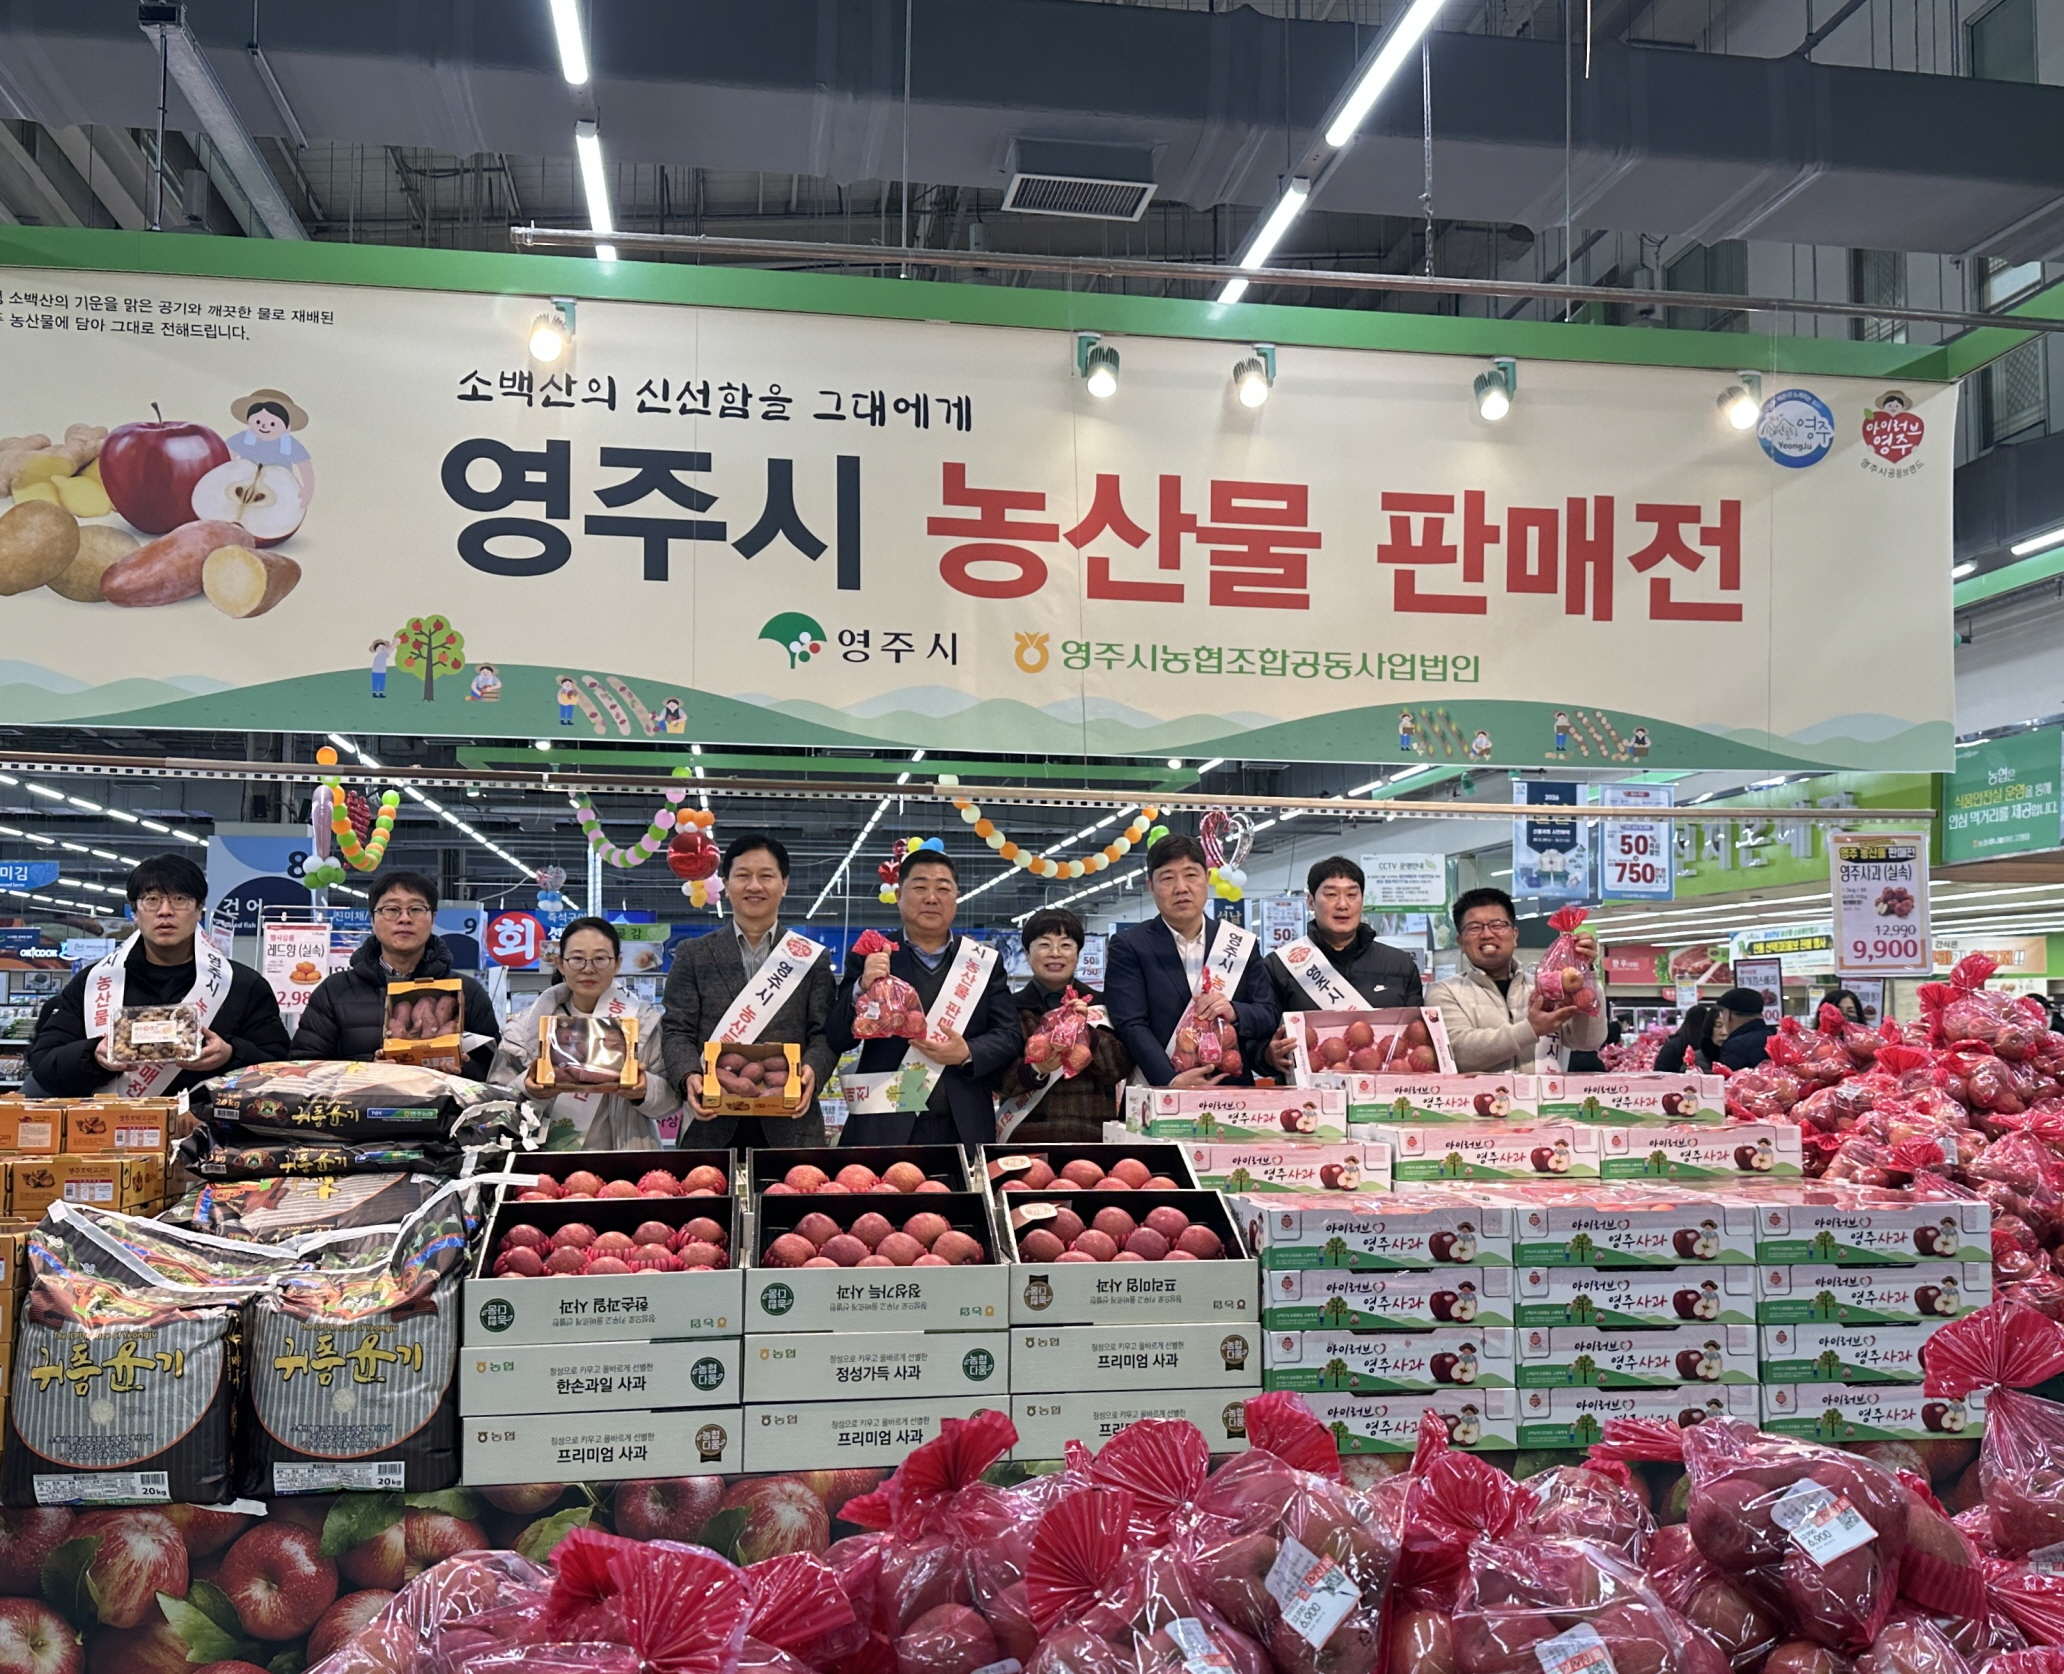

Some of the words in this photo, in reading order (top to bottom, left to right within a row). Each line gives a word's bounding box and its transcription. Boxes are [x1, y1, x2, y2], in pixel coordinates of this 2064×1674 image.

[9, 291, 69, 309] 소백산의
[75, 295, 119, 312] 기운을
[124, 296, 153, 313] 맑은
[158, 299, 202, 317] 공기와
[207, 302, 251, 319] 깨끗한
[257, 306, 286, 322] 물로
[291, 308, 335, 325] 재배된
[9, 312, 69, 330] 농산물에
[75, 316, 106, 332] 담아
[110, 319, 155, 336] 그대로
[160, 322, 250, 341] 전해드립니다.
[456, 368, 617, 411] 소백산의
[636, 376, 794, 423] 신선함을
[812, 387, 974, 433] 그대에게
[1866, 419, 1923, 436] 아이러브
[1873, 433, 1913, 455] 영주
[441, 437, 861, 590] 영주시
[926, 461, 1322, 610] 농산물
[1377, 490, 1744, 623] 판매전
[837, 628, 959, 666] 영주시
[1061, 638, 1481, 683] 영주시농협조합공동사업법인
[1620, 834, 1649, 856] 50
[287, 851, 309, 878] 8
[1378, 862, 1398, 870] CCTV
[1615, 863, 1655, 884] 750
[1840, 864, 1881, 882] 영주사과
[1884, 864, 1912, 882] (실속)
[464, 917, 478, 935] 9
[1875, 924, 1917, 937] 12,990
[493, 918, 535, 960] 회
[1273, 929, 1291, 941] 50
[267, 944, 296, 957] 레드향
[299, 943, 325, 958] (실속)
[1219, 932, 1243, 974] 영주시
[1853, 940, 1918, 962] 9,900
[1083, 956, 1095, 965] 50
[206, 953, 222, 998] 영주시
[755, 960, 793, 1006] 영주시
[954, 958, 980, 1001] 농산물
[1306, 963, 1345, 1005] 영주시
[94, 975, 113, 1027] 농산물
[1394, 1085, 1430, 1095] 아이러브
[1199, 1100, 1235, 1111] 아이러브
[1423, 1096, 1470, 1108] 영주사과
[1228, 1112, 1276, 1125] 영주사과
[1649, 1138, 1687, 1148] 아이러브
[1232, 1155, 1271, 1166] 아이러브
[1680, 1150, 1729, 1163] 영주사과
[1264, 1167, 1315, 1181] 영주사과
[1326, 1221, 1371, 1233] 아이러브
[1572, 1219, 1616, 1231] 아이러브
[1814, 1217, 1858, 1228] 아이러브
[1363, 1236, 1424, 1251] 영주사과
[1609, 1233, 1667, 1248] 영주사과
[1850, 1231, 1908, 1245] 영주사과
[1096, 1279, 1122, 1293] 사과
[1127, 1279, 1176, 1293] 프리미엄
[1815, 1276, 1859, 1288] 아이러브
[836, 1284, 864, 1300] 사과
[1851, 1291, 1909, 1304] 영주사과
[560, 1298, 588, 1314] 사과
[593, 1296, 649, 1313] 한손과일
[1326, 1343, 1372, 1355] 아이러브
[1097, 1354, 1148, 1370] 프리미엄
[1152, 1352, 1179, 1368] 사과
[1364, 1358, 1425, 1374] 영주사과
[836, 1366, 891, 1382] 정성가득
[893, 1365, 922, 1381] 사과
[556, 1377, 613, 1394] 한손과일
[618, 1376, 647, 1391] 사과
[1822, 1394, 1866, 1405] 아이러브
[1858, 1408, 1916, 1423] 영주사과
[837, 1430, 892, 1447] 프리미엄
[896, 1429, 923, 1445] 사과
[557, 1447, 613, 1464] 프리미엄
[618, 1445, 648, 1461] 사과
[1807, 1530, 1832, 1547] 6,900
[1300, 1602, 1321, 1629] 6,900
